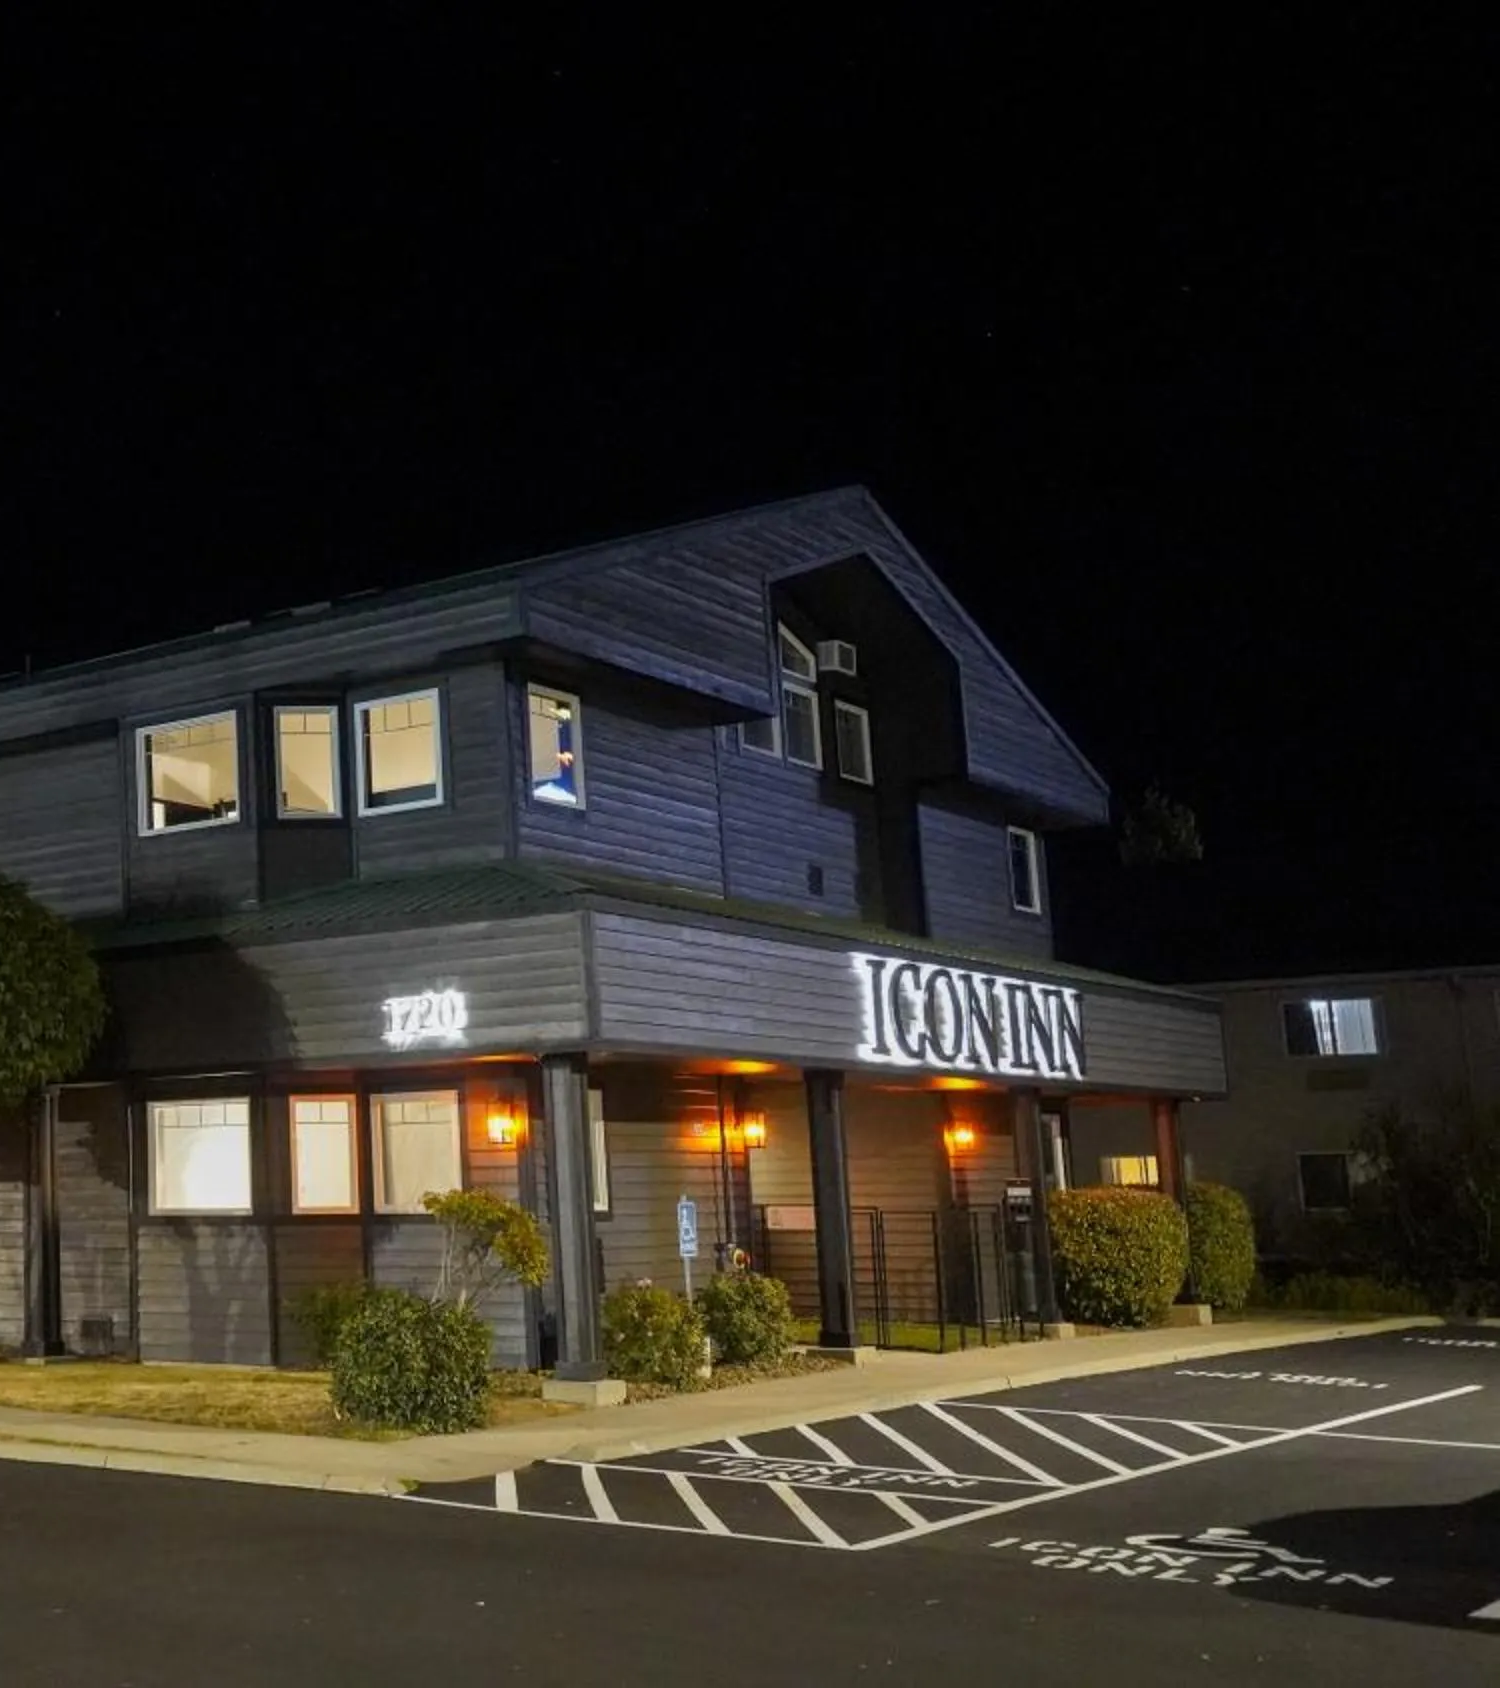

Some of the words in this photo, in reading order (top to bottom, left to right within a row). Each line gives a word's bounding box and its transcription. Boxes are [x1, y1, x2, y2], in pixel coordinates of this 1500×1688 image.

[381, 993, 464, 1037] 1720
[864, 958, 999, 1072] ICON
[1003, 982, 1088, 1076] INN
[698, 1457, 849, 1475] ICON
[860, 1472, 979, 1488] INN
[720, 1467, 880, 1486] ONLY
[987, 1537, 1200, 1567] ICON
[1224, 1562, 1396, 1588] INN
[1030, 1555, 1262, 1586] ONLY
